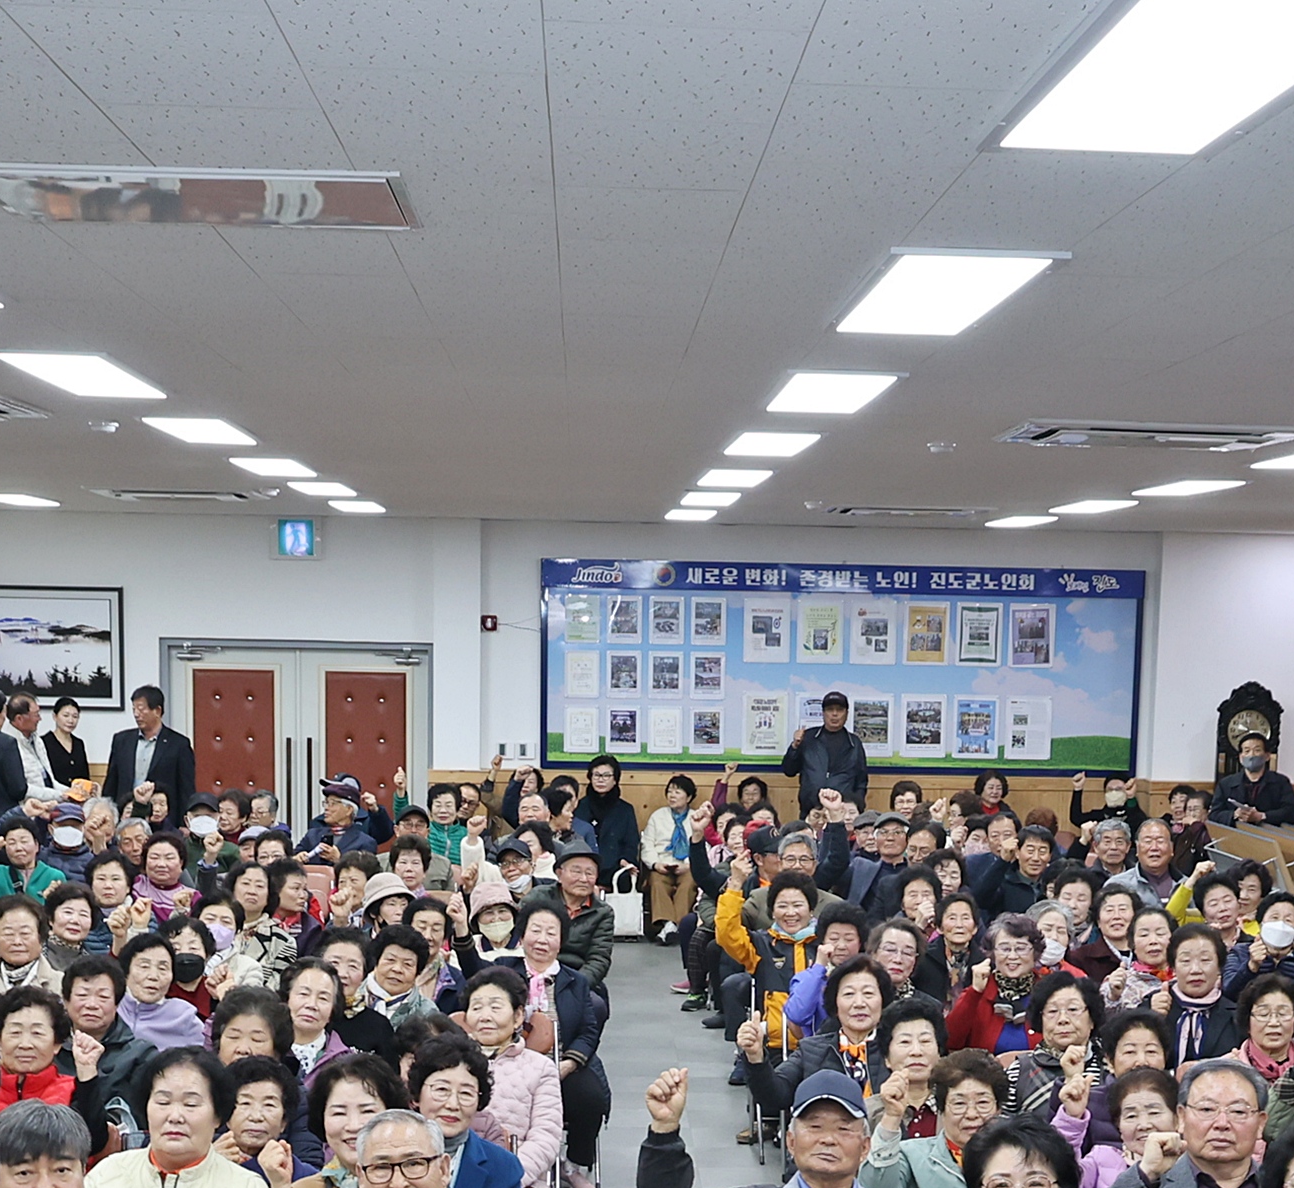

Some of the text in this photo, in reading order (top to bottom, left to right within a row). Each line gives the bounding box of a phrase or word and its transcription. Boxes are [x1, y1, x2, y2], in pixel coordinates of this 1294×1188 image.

[686, 567, 1035, 591] 새로운 변화! 존경받는 노인! 진도군노인회
